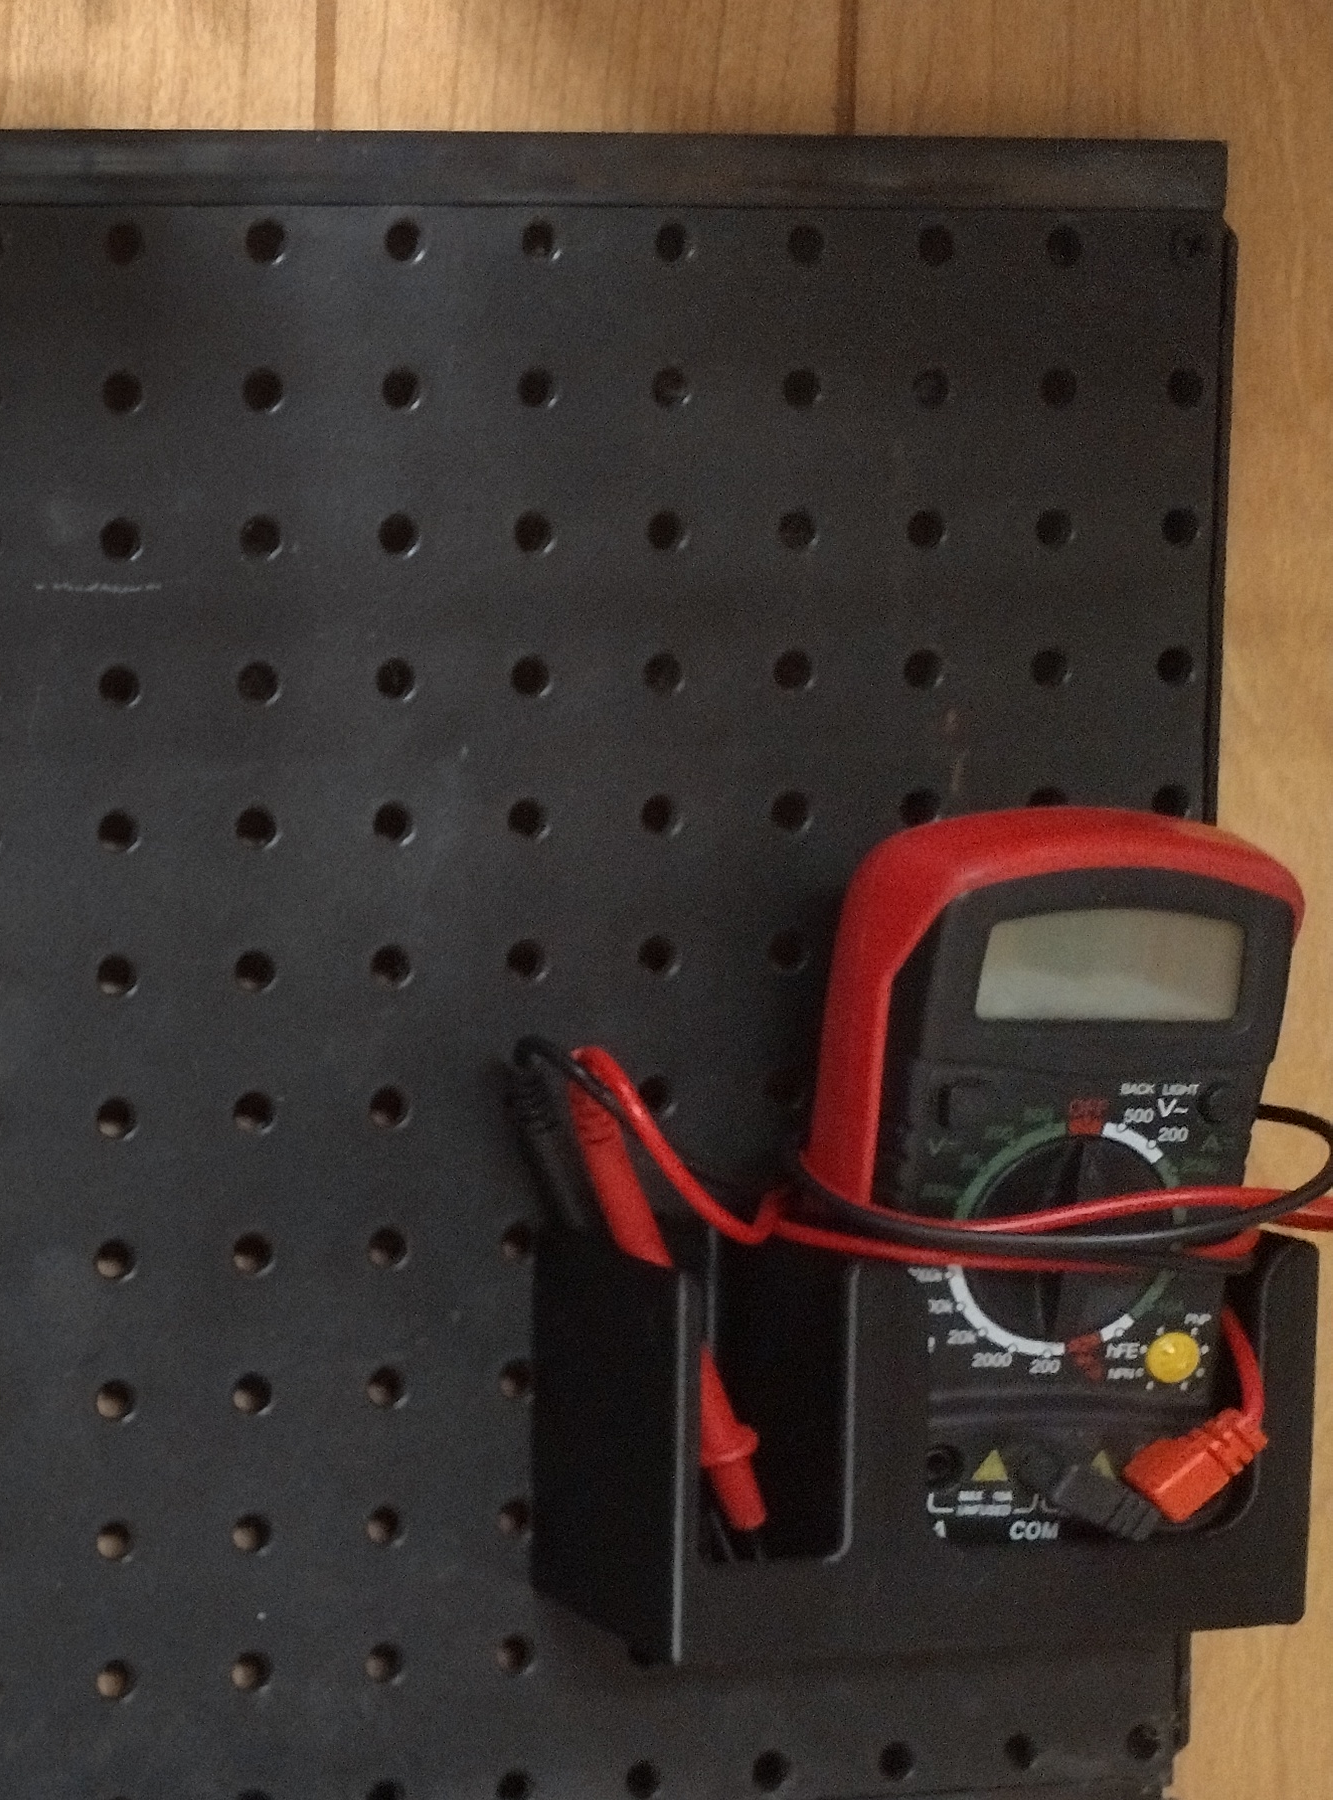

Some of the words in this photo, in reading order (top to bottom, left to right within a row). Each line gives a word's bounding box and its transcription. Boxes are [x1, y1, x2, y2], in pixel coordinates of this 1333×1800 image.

[1120, 1083, 1155, 1096] BACK
[1162, 1083, 1200, 1096] LIGHT
[1124, 1107, 1155, 1124] 500
[1157, 1126, 1189, 1142] 200
[971, 1352, 1013, 1368] 2000
[1029, 1358, 1061, 1375] 200
[1009, 1520, 1060, 1541] COM
